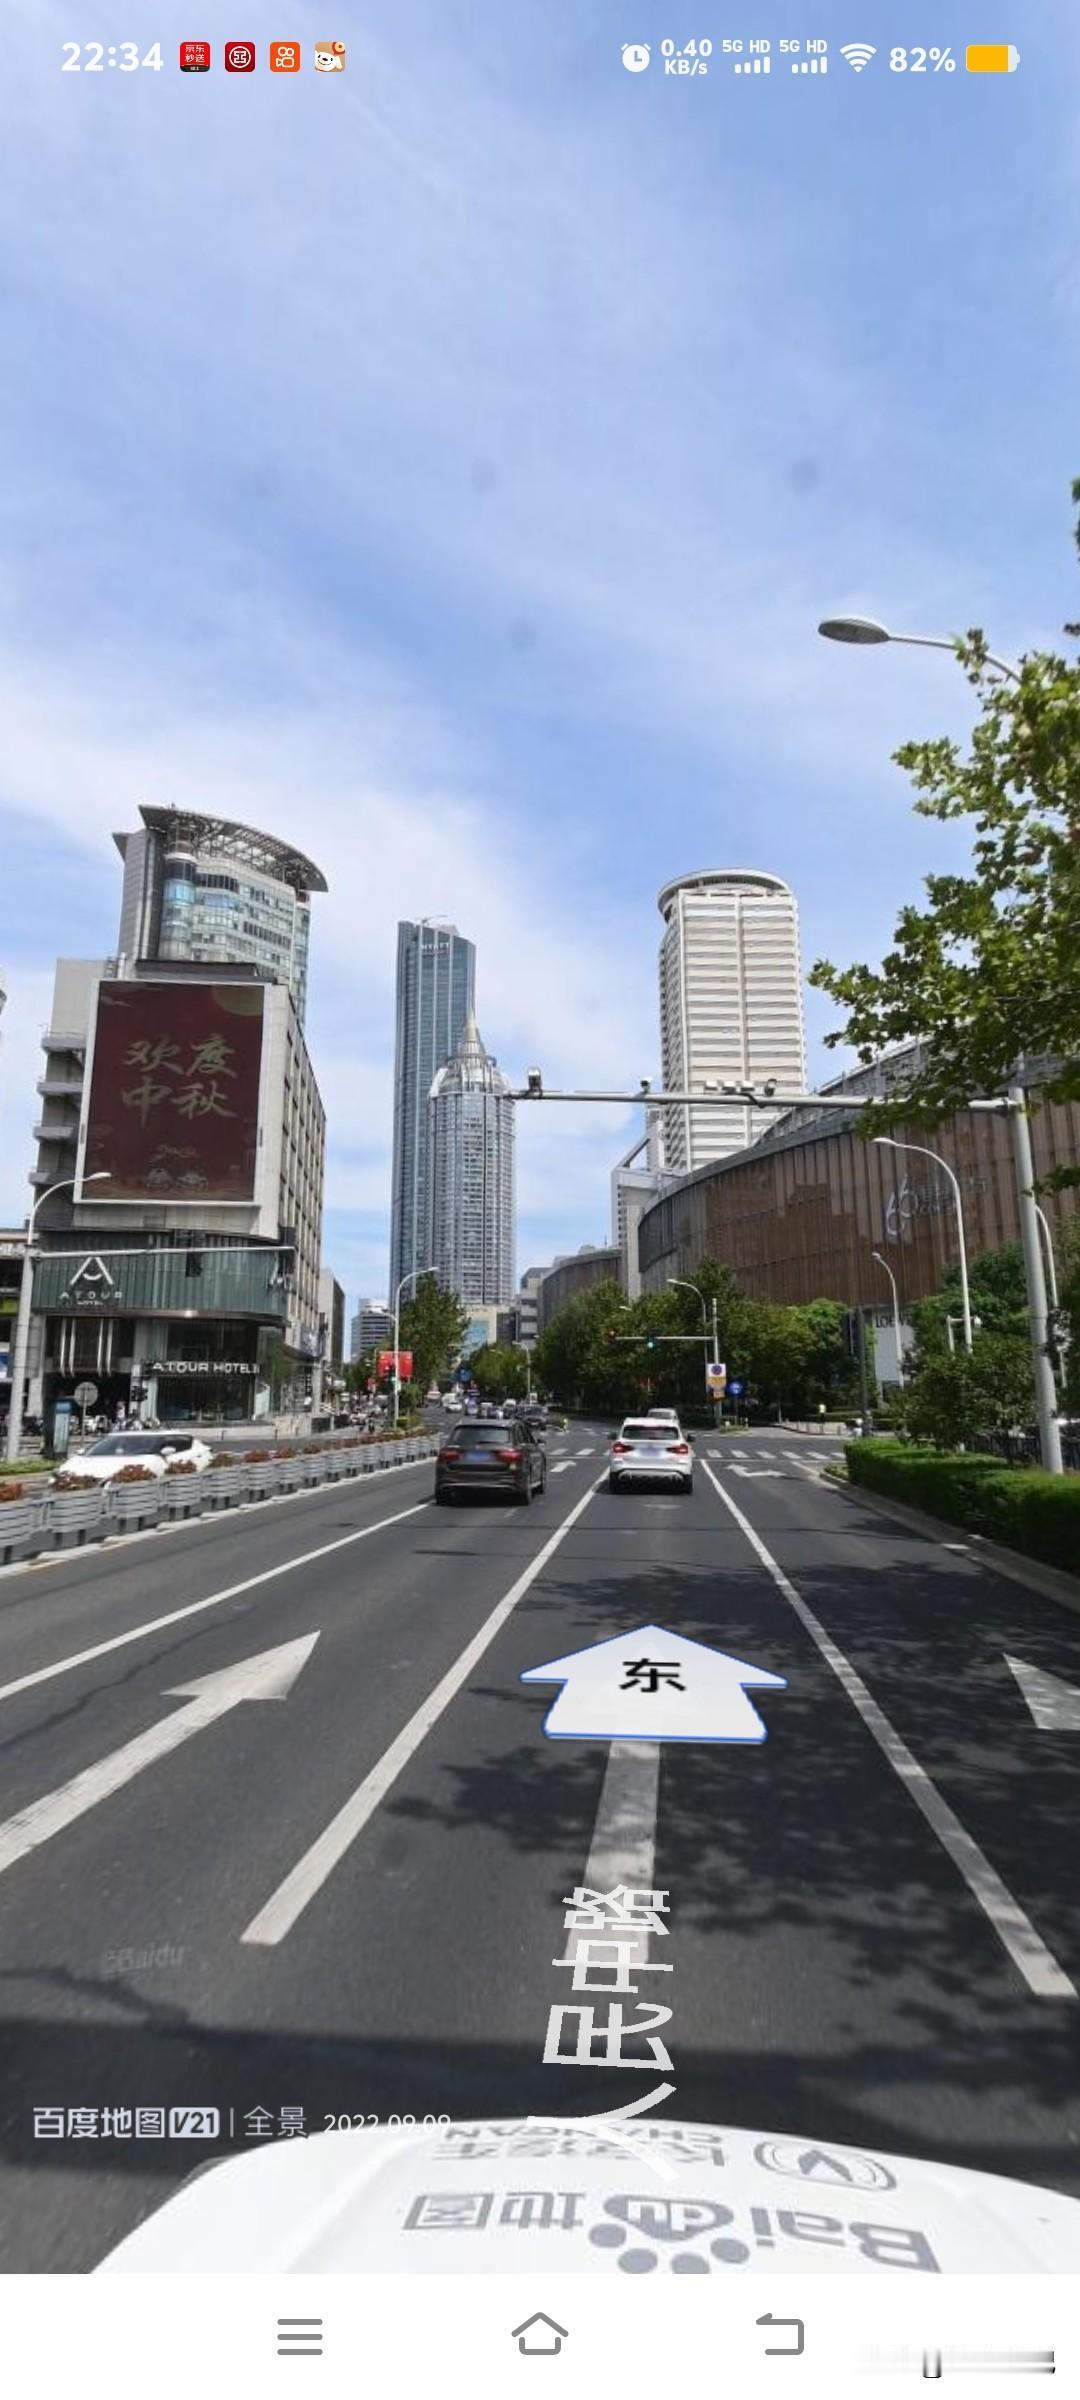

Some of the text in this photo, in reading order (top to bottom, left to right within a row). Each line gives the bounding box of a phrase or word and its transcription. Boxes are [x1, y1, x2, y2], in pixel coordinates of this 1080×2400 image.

[121, 1033, 239, 1079] 欢度
[120, 1077, 239, 1128] 中秋
[60, 1290, 123, 1300] ATOUR
[153, 1361, 209, 1374] ATOUR
